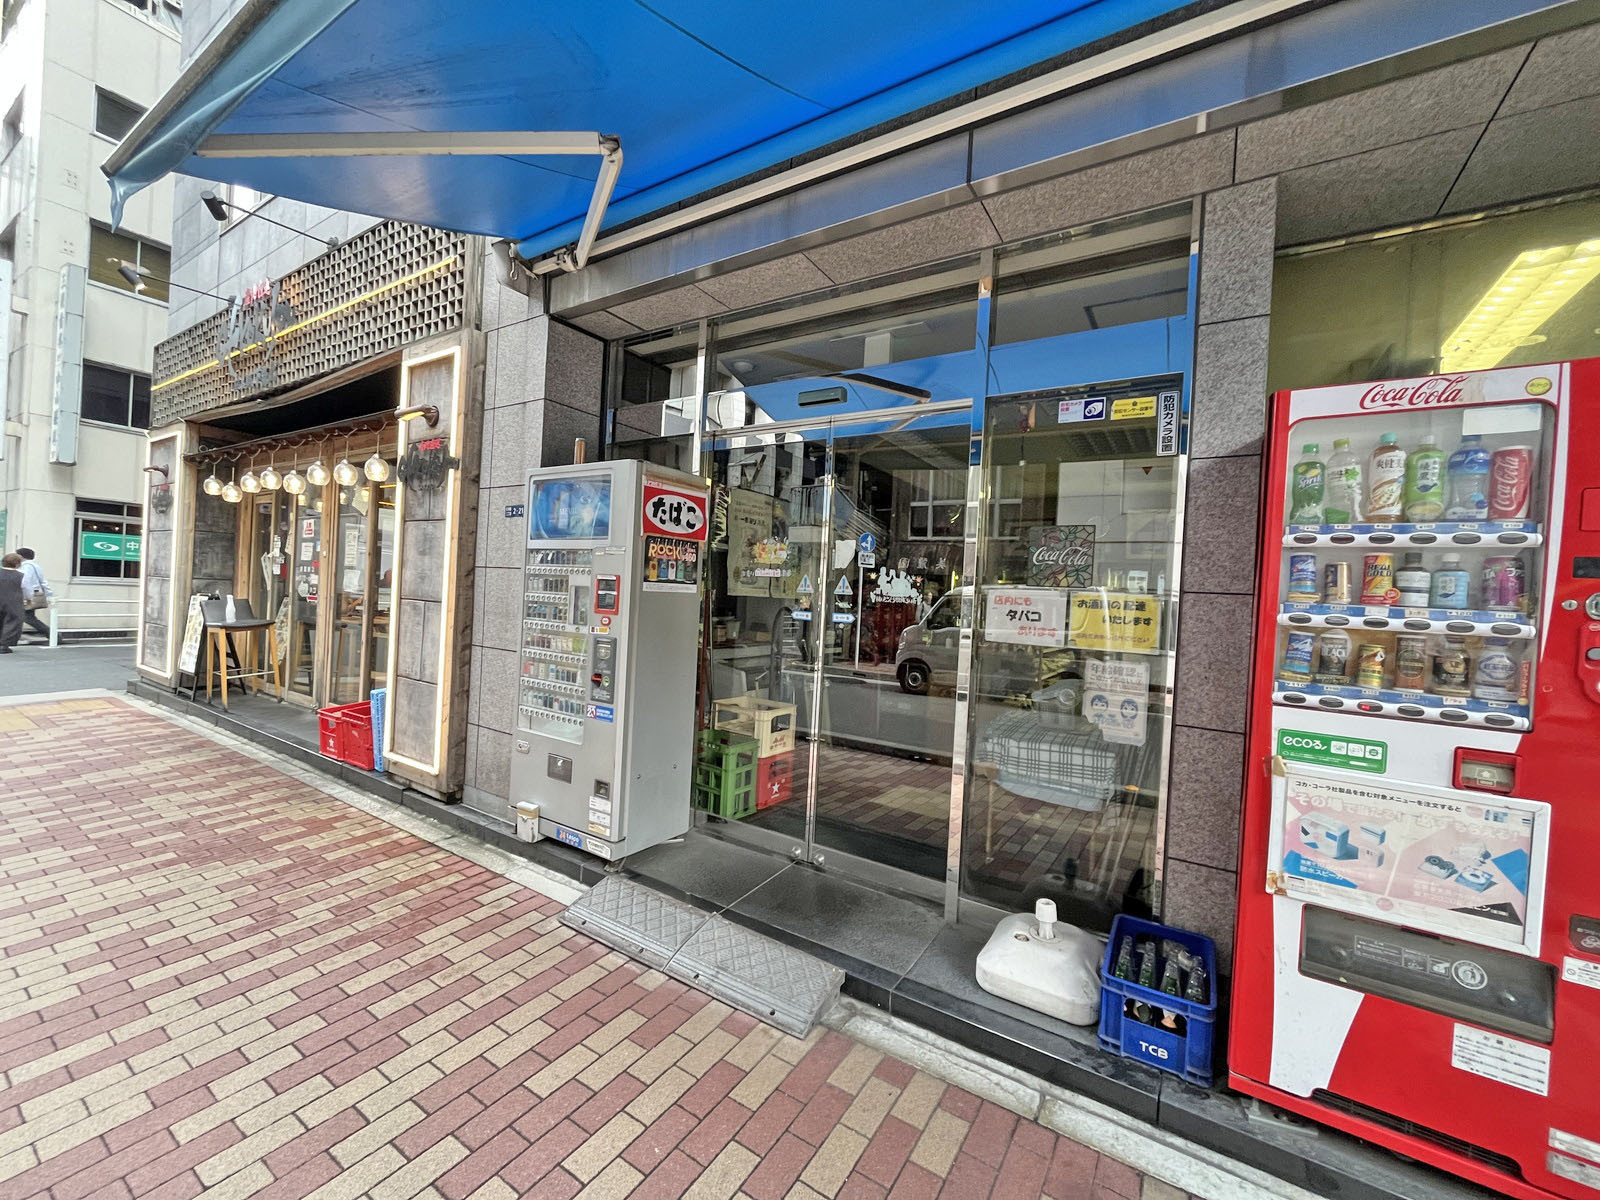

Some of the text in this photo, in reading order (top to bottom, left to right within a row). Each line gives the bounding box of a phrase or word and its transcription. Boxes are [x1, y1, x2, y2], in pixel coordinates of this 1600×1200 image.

[1359, 375, 1470, 410] Coca-Cola
[1162, 394, 1175, 453] 防犯カメラ設置
[652, 497, 697, 530] たばこ
[648, 543, 681, 560] ROCK
[1032, 546, 1090, 566] Coca-Cola
[1368, 563, 1391, 571] REAL
[994, 595, 1033, 607] 店内にも
[1006, 609, 1042, 622] タバコ
[1102, 615, 1153, 627] いたします
[1018, 625, 1058, 638] あります
[1296, 780, 1462, 813] コカ・コーラ社製品を含む対象メニューを注文すると
[1139, 1041, 1169, 1060] TCB
